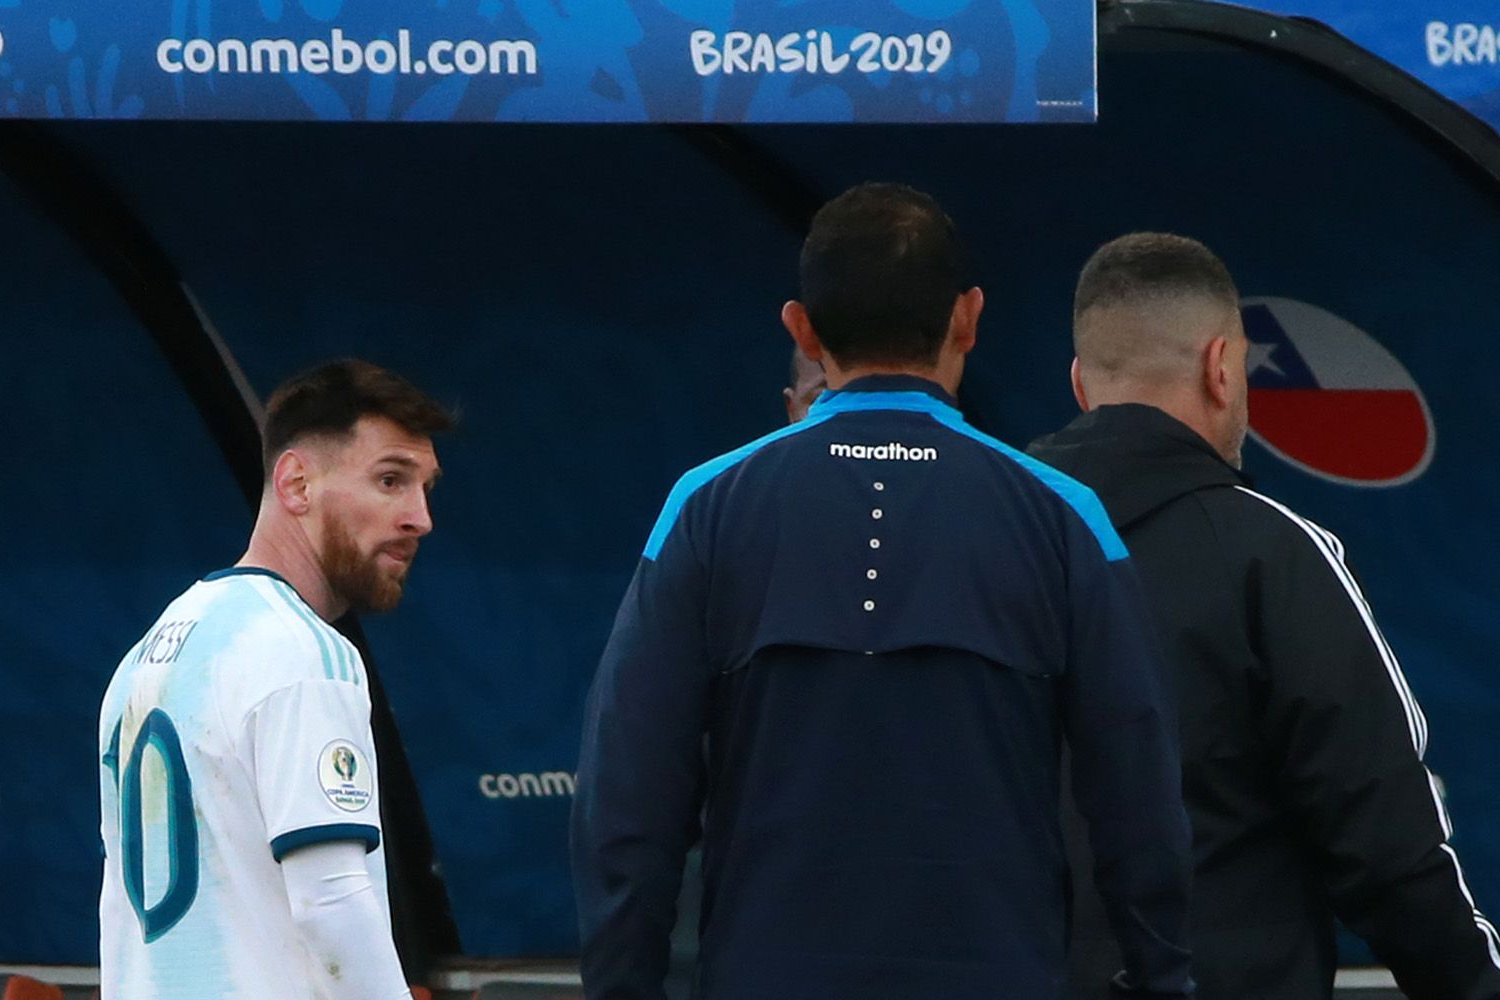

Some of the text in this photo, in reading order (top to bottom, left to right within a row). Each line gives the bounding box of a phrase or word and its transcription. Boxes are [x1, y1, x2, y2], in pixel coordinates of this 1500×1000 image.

[156, 29, 537, 75] conmebol.com
[850, 30, 952, 73] 2019
[1425, 20, 1500, 67] BRA
[830, 442, 938, 461] marathon
[131, 619, 198, 664] MESSI
[479, 771, 578, 799] conm
